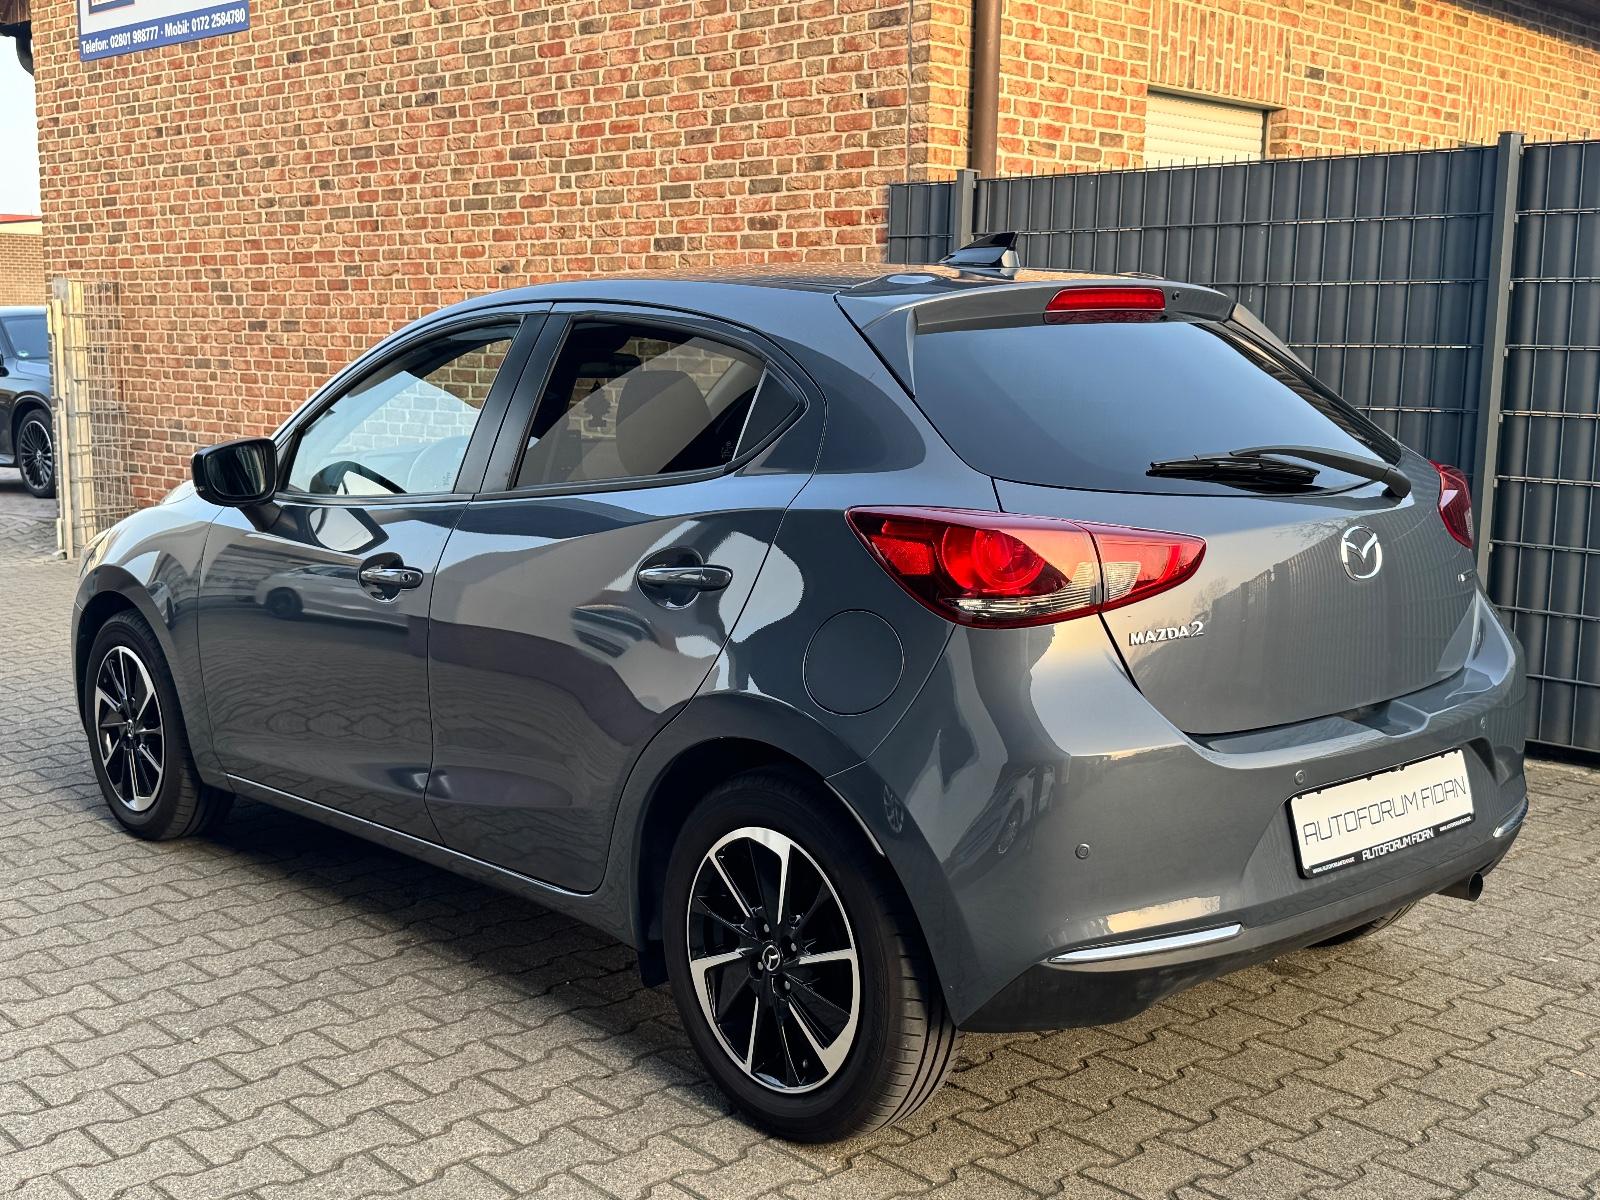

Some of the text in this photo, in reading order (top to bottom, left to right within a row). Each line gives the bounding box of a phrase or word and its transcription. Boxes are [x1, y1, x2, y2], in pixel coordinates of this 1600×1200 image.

[81, 7, 246, 54] Telefon: 02801 988777 Mobil: 0172 2584780
[1302, 775, 1467, 846] AUTOFORUM FIDAN
[1361, 827, 1435, 861] AUTOFORUM FIDAN
